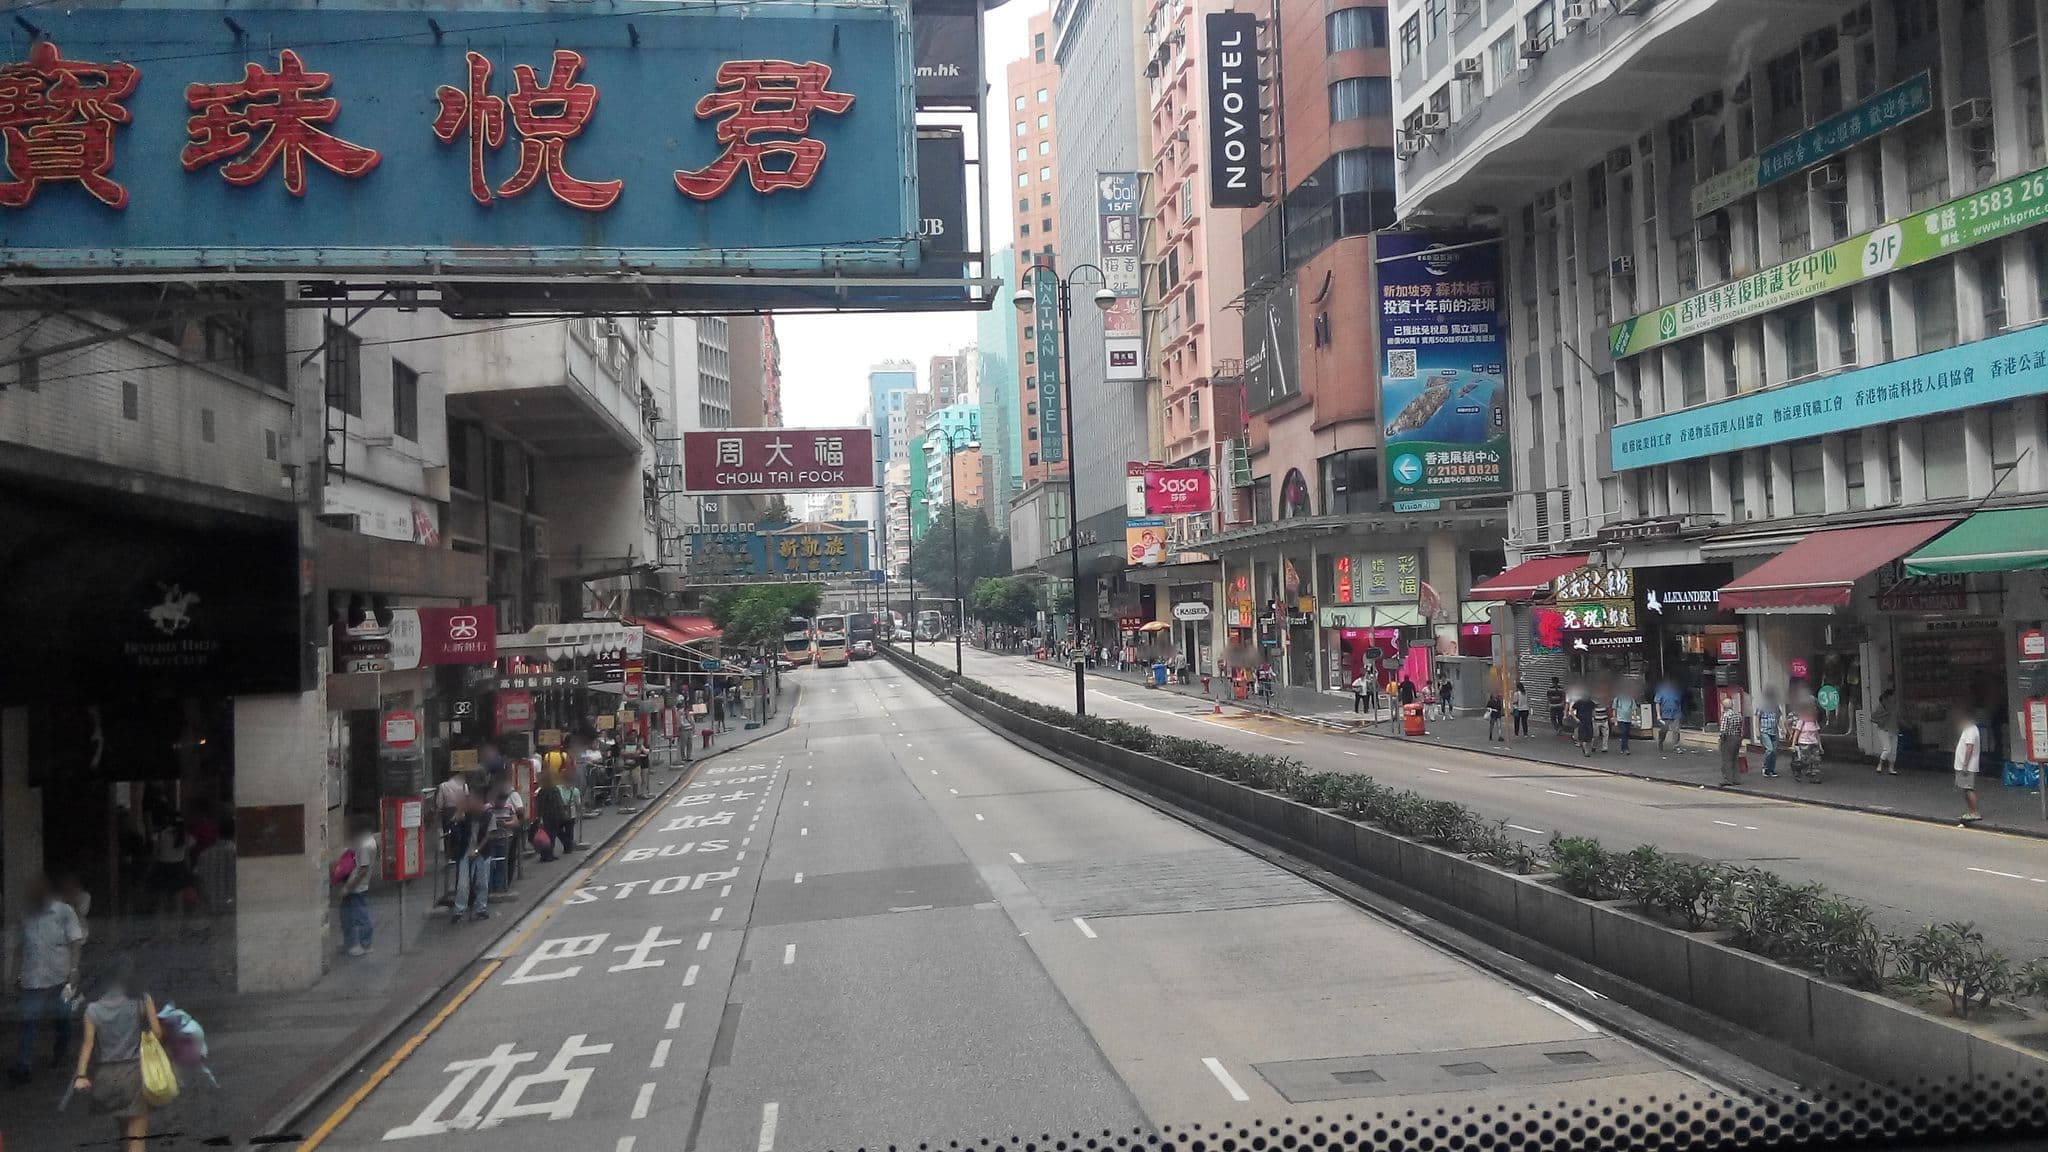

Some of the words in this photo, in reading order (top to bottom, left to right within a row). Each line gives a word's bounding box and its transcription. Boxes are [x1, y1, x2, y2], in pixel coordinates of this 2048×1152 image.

[914, 63, 960, 77] m.hk
[1221, 30, 1247, 188] NOVOTEL
[1969, 186, 2013, 221] 3583
[2021, 174, 2048, 202] 26
[1108, 202, 1133, 212] 15/F
[1109, 244, 1133, 253] 15/F
[1869, 236, 1896, 266] 3/F
[1383, 284, 1432, 298] 新加坡旁
[1681, 249, 1837, 323] 香港專業復康護老中心
[1384, 297, 1495, 315] 投資十年前的深圳
[1041, 280, 1055, 357] NATHAN
[1854, 365, 1975, 407] 香港物流科技人員協會
[1043, 370, 1057, 434] HOTEL
[716, 436, 844, 468] 周大福
[1425, 450, 1500, 465] 香港展銷中心
[715, 472, 764, 485] CHOW
[768, 470, 794, 484] TAI
[799, 470, 845, 483] FOOK
[1438, 465, 1466, 476] 2136
[1469, 463, 1499, 475] 0828
[705, 502, 718, 512] 63
[1398, 554, 1417, 595] 彩福
[1663, 591, 1711, 603] ALEXANDER
[1179, 608, 1209, 616] KAISER
[1590, 637, 1634, 646] ALEXANDER
[706, 764, 767, 775] BUS
[688, 775, 767, 789] STOP
[672, 790, 755, 808] 巴士
[658, 811, 736, 833] 站
[620, 839, 730, 863] BUS
[564, 866, 741, 906] STOP
[501, 926, 682, 986] 巴士
[381, 1034, 614, 1141] 站
